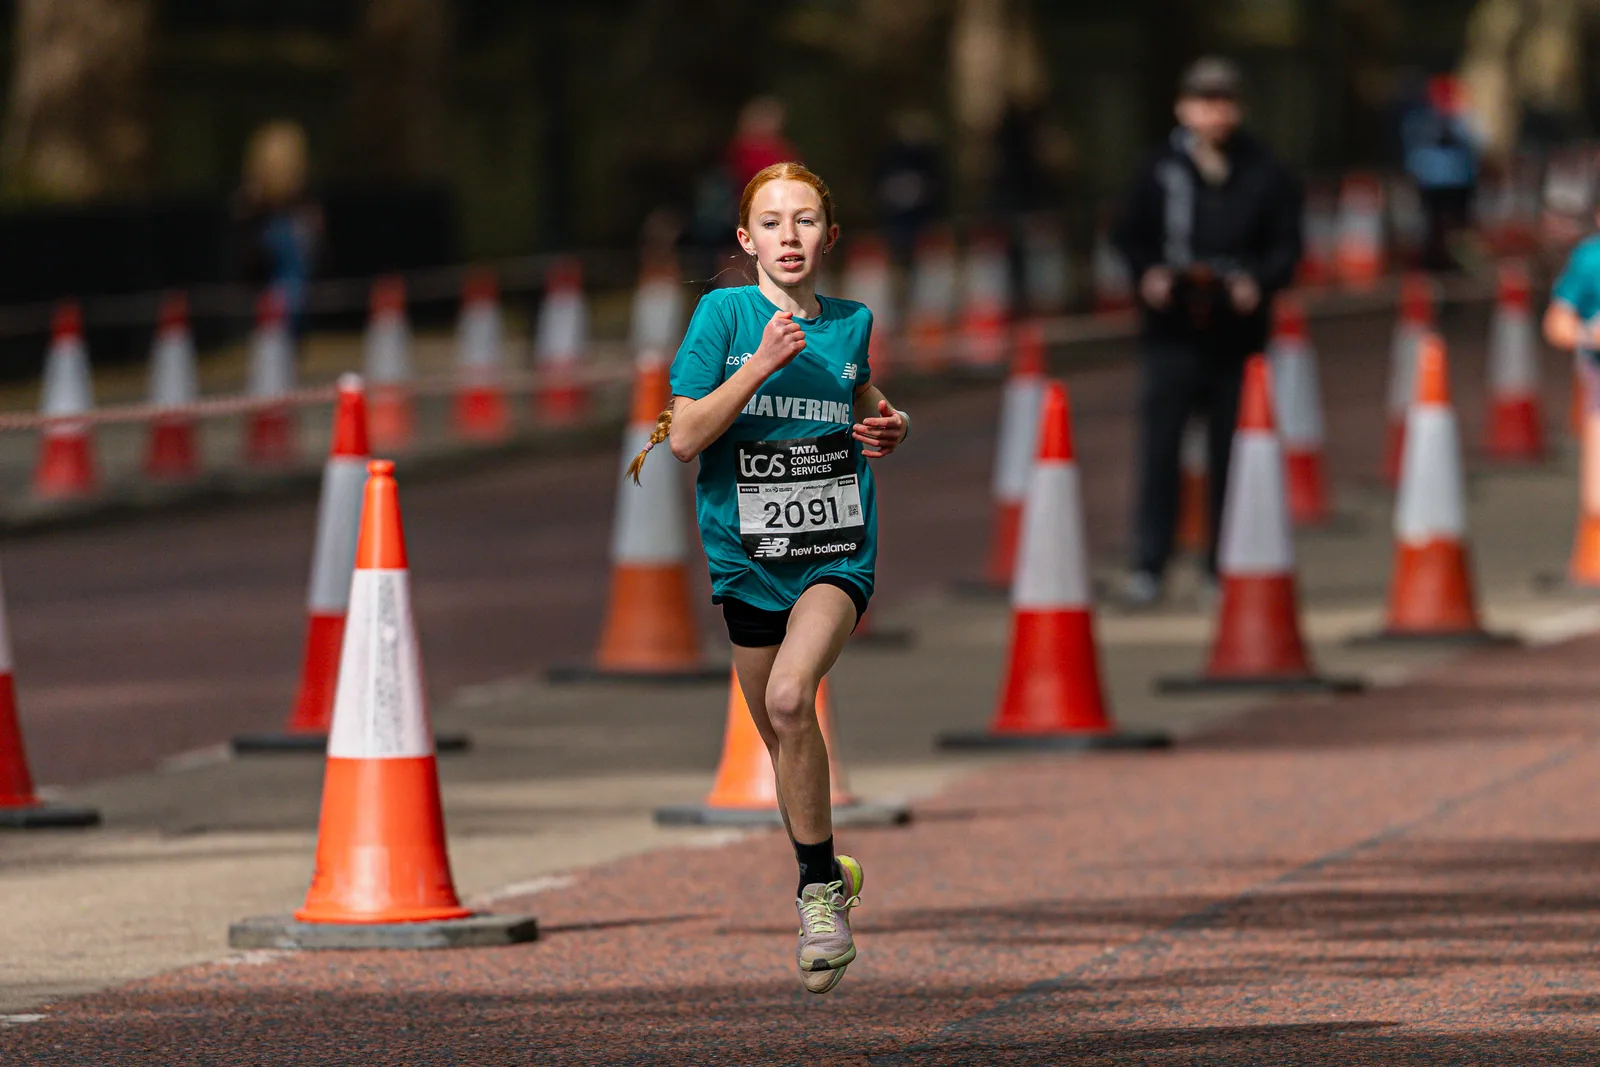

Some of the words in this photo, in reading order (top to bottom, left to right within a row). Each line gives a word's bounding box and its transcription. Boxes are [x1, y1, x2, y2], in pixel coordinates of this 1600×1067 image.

[741, 394, 850, 425] HAVERING
[789, 445, 819, 455] TATA
[790, 449, 849, 466] CONSULTANCY
[739, 448, 786, 477] tcs
[791, 463, 832, 476] SERVICES
[763, 496, 840, 529] 2091
[790, 546, 812, 557] new
[813, 542, 857, 554] balance
